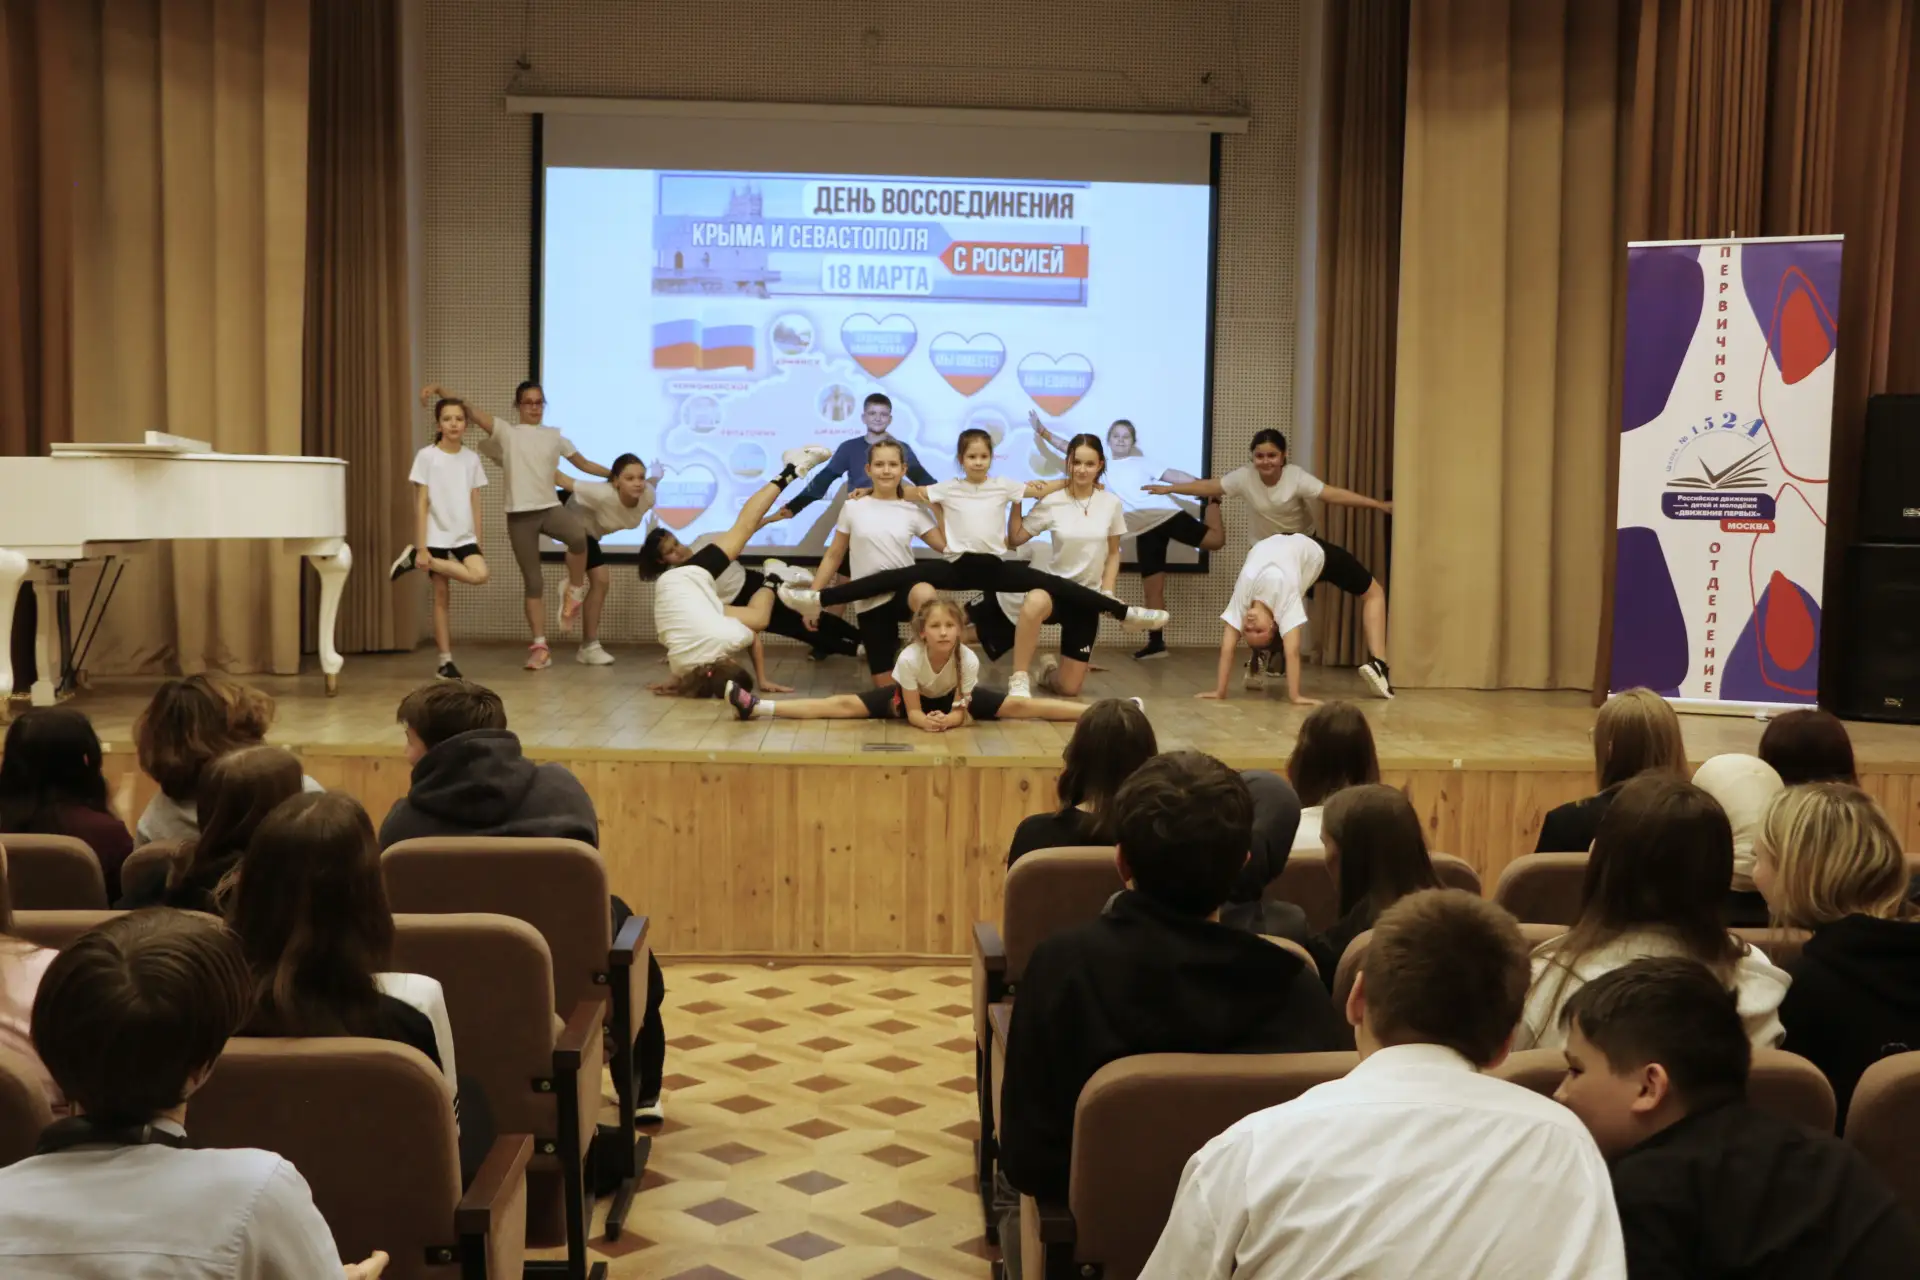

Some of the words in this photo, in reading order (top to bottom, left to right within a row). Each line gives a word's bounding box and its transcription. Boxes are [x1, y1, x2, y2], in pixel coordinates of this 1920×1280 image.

[814, 186, 875, 214] ДЕНЬ
[882, 188, 1073, 219] ВОССОЕДИНЕНИЯ
[692, 223, 765, 247] КРЫМА
[771, 225, 783, 247] И
[789, 225, 928, 250] СЕВАСТОПОЛЯ
[953, 246, 967, 272] С
[972, 245, 1064, 274] РОССИЕЙ
[827, 264, 850, 290] 18
[858, 264, 929, 291] МАРТА
[1714, 246, 1731, 401] ПЕРВИЧНОЕ
[1727, 522, 1770, 530] МОСКВА
[1703, 542, 1721, 692] ОТДЕЛЕНИЕ
